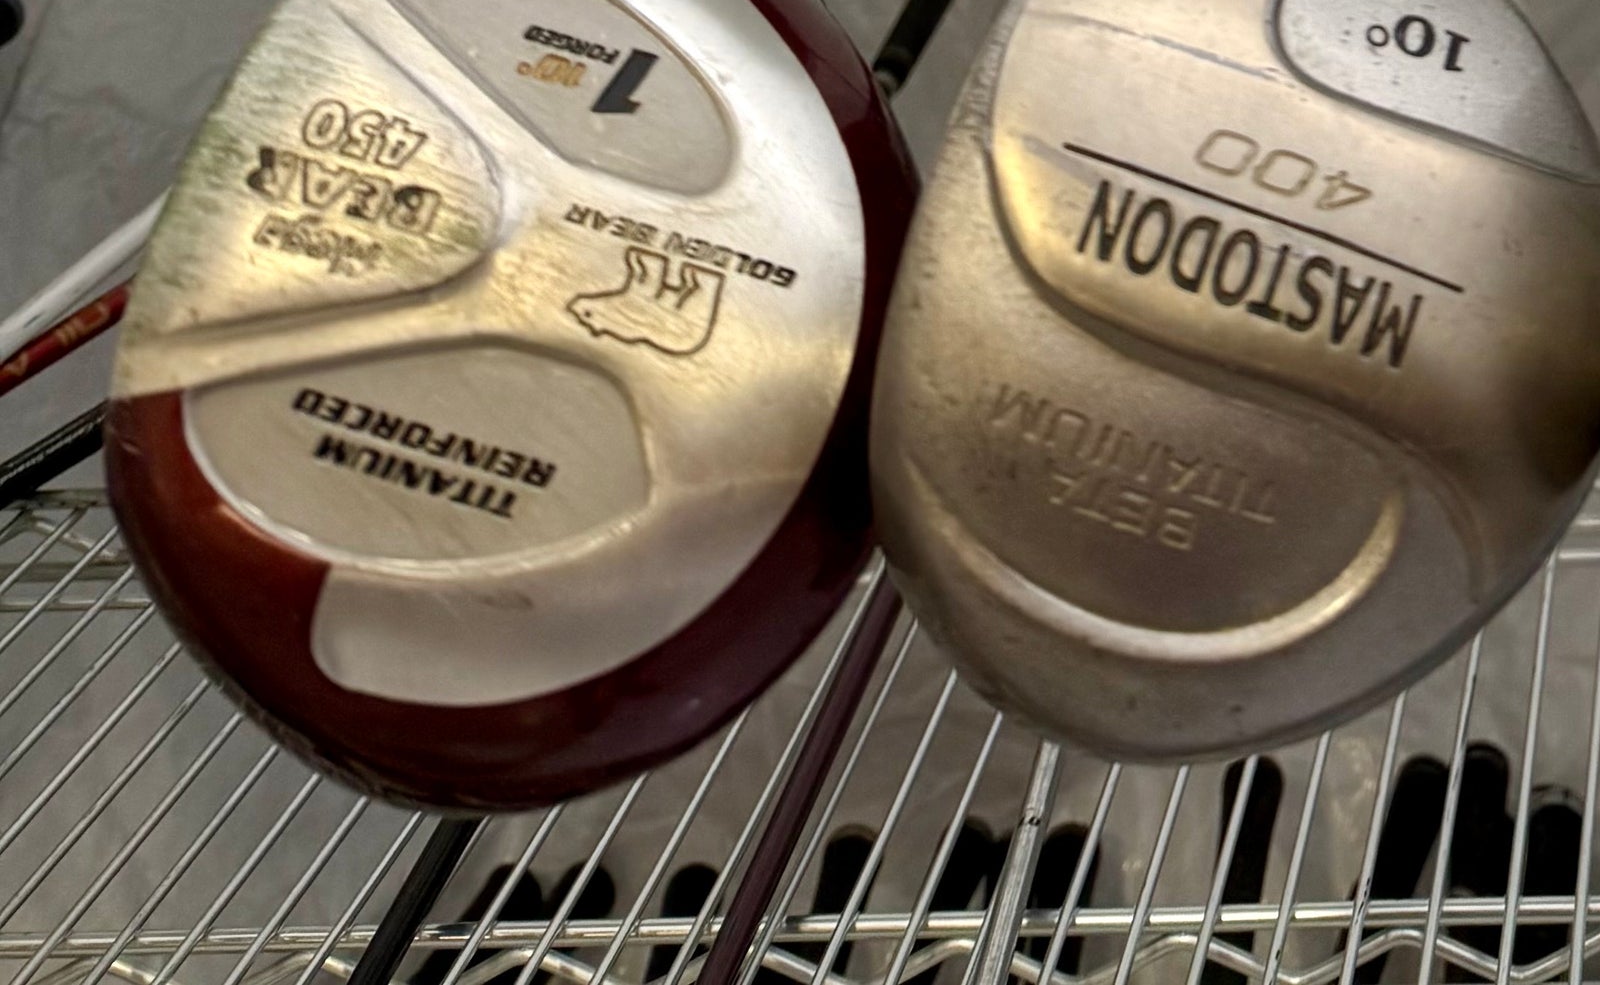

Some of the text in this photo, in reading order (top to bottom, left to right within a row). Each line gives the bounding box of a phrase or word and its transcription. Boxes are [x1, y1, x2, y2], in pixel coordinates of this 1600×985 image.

[522, 24, 620, 65] FORGED
[590, 47, 660, 114] 1
[1365, 14, 1471, 72] 10°
[302, 98, 428, 171] 450
[1194, 129, 1373, 211] 400
[247, 145, 441, 235] BEAR
[563, 203, 798, 288] GOLDEN BEAR
[1075, 179, 1424, 369] MASTODON
[292, 387, 557, 488] REINFORCED
[313, 432, 518, 519] TITANIUM
[988, 382, 1277, 524] TITANIUM
[1048, 458, 1195, 551] BETA
